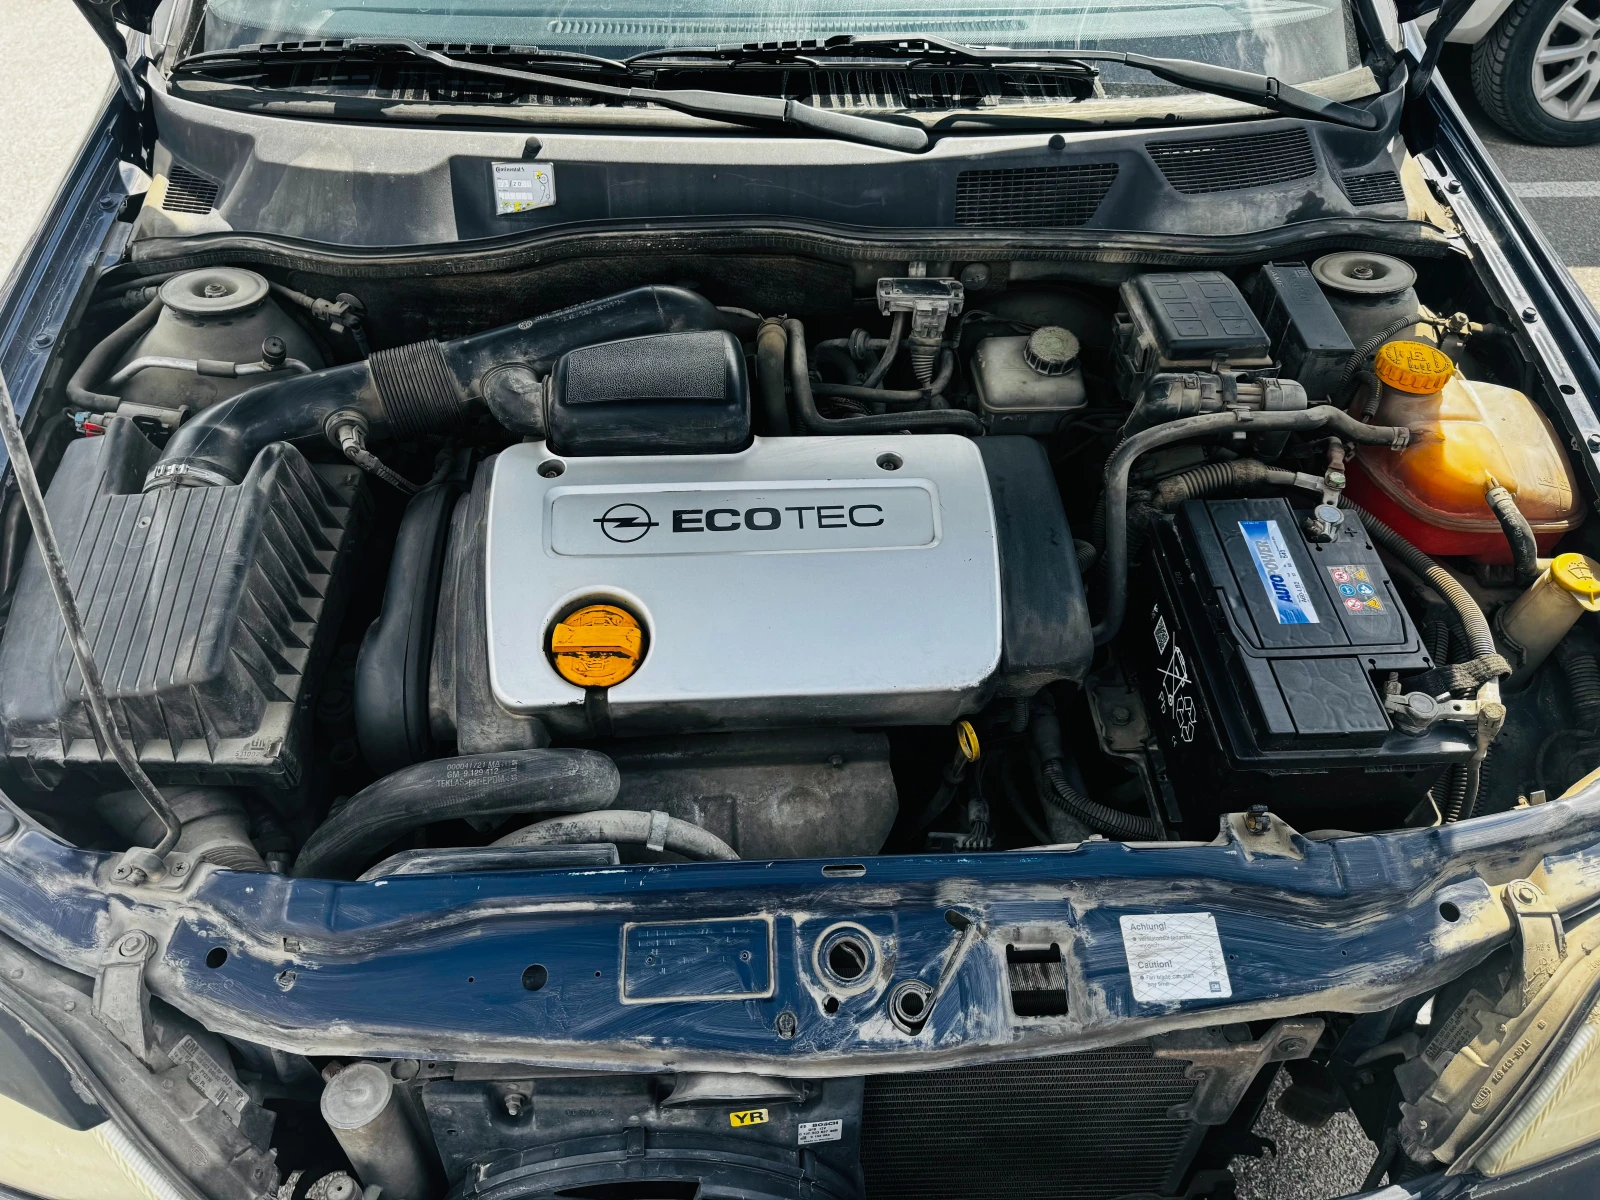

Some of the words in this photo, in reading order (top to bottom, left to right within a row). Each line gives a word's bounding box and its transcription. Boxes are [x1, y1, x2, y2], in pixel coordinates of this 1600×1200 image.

[672, 504, 885, 533] ECOTEC
[1255, 540, 1294, 604] AUTOPOWER
[1137, 960, 1173, 969] Caution!
[184, 1038, 200, 1055] GM
[1425, 1042, 1440, 1058] GM
[734, 1111, 764, 1124] YR
[812, 1120, 839, 1128] BOSCH
